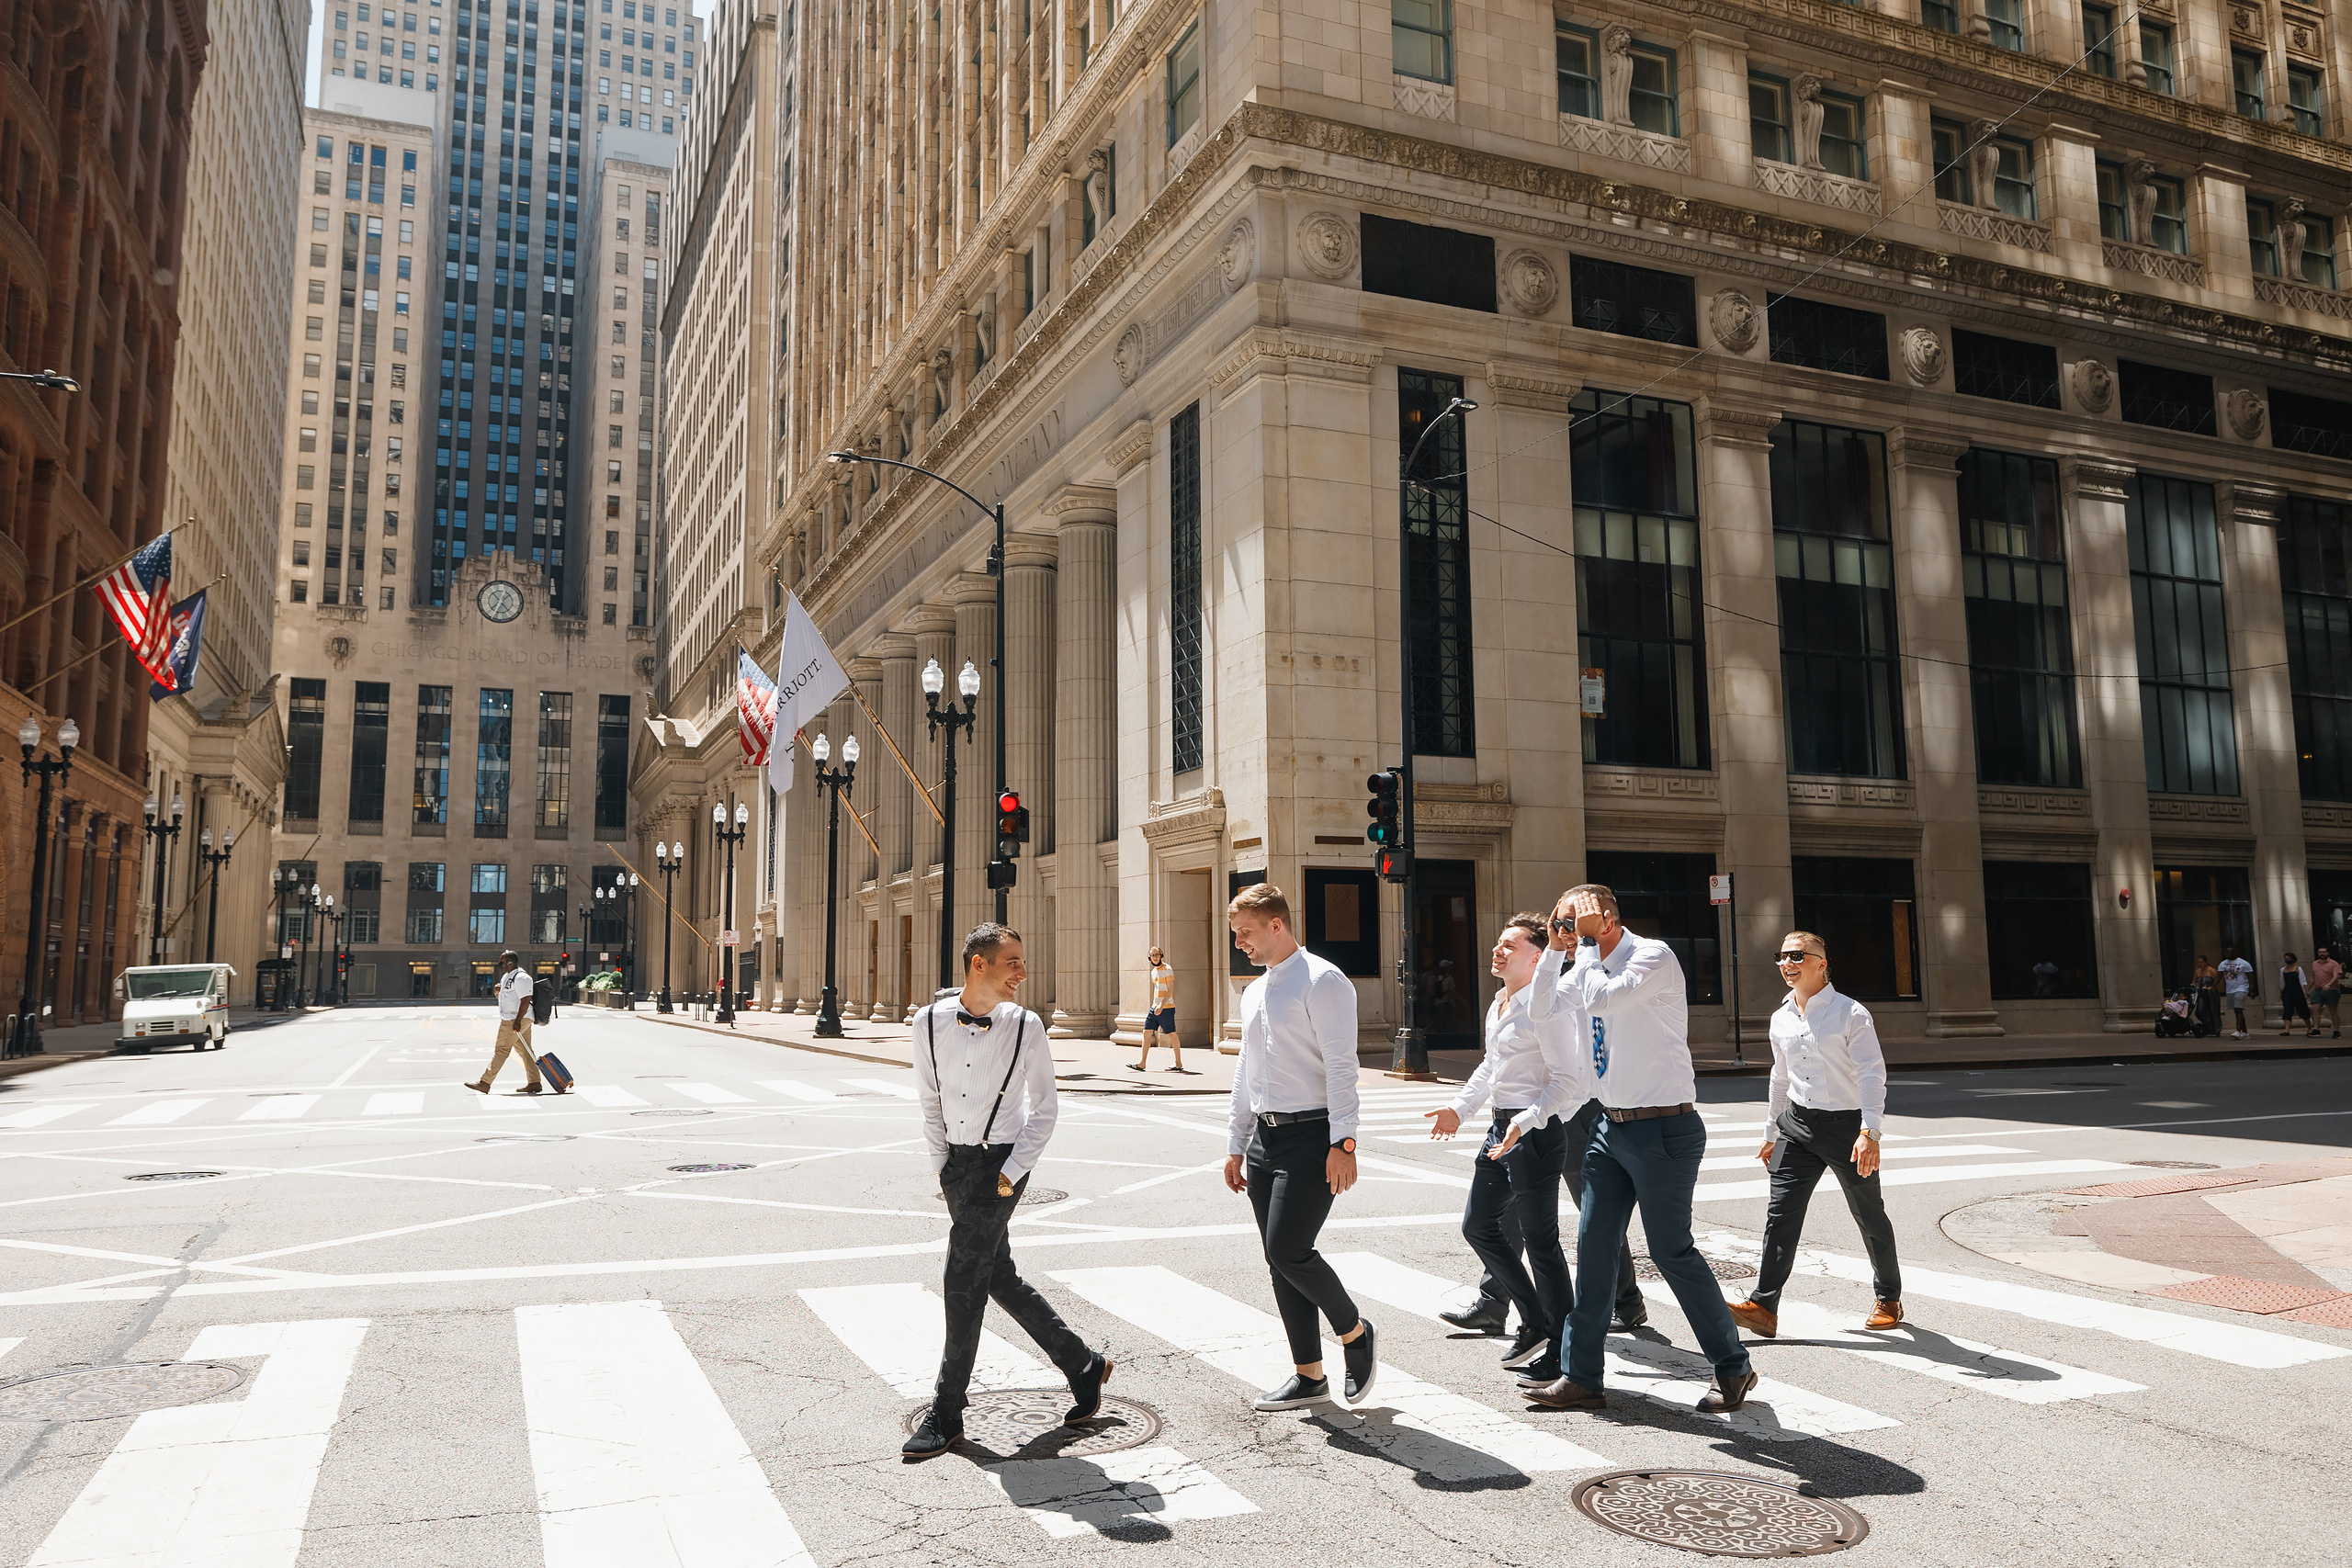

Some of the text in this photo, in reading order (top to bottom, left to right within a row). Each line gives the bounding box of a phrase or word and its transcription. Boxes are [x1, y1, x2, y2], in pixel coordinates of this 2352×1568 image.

[903, 535, 927, 580] AND
[934, 488, 975, 552] TRUST
[981, 400, 1065, 508] COMPANY
[371, 641, 622, 670] CHICAGO BOARD OF TRADE
[776, 658, 820, 713] RRIOTT
